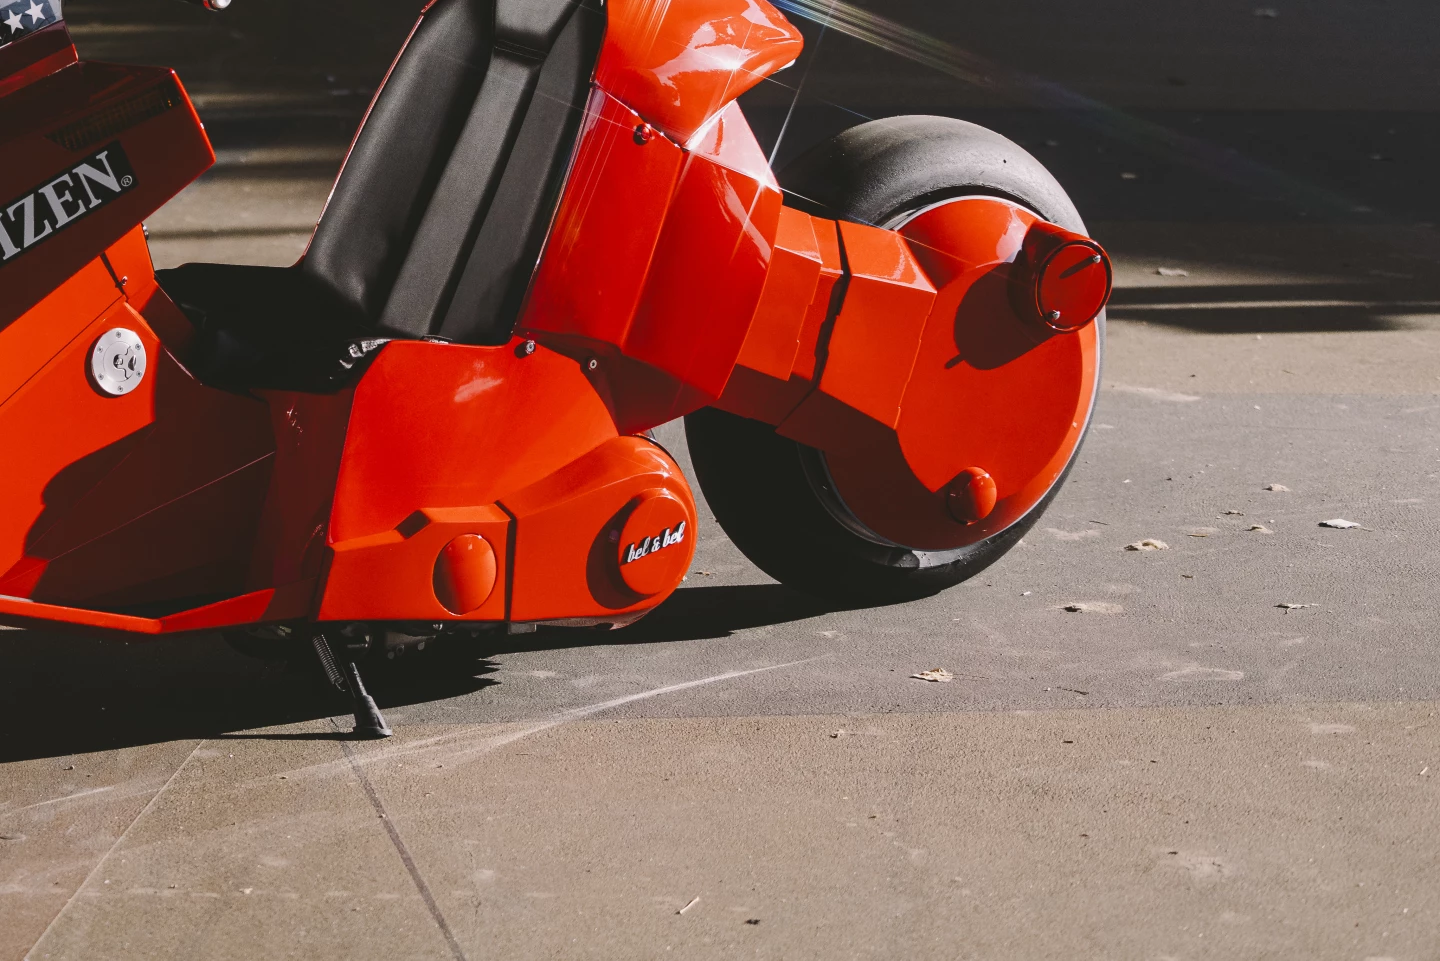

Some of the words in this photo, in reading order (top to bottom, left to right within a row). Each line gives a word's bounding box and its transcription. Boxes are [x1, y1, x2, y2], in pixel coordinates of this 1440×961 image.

[627, 536, 651, 563] bel
[651, 536, 661, 553] &
[662, 520, 686, 548] bel
